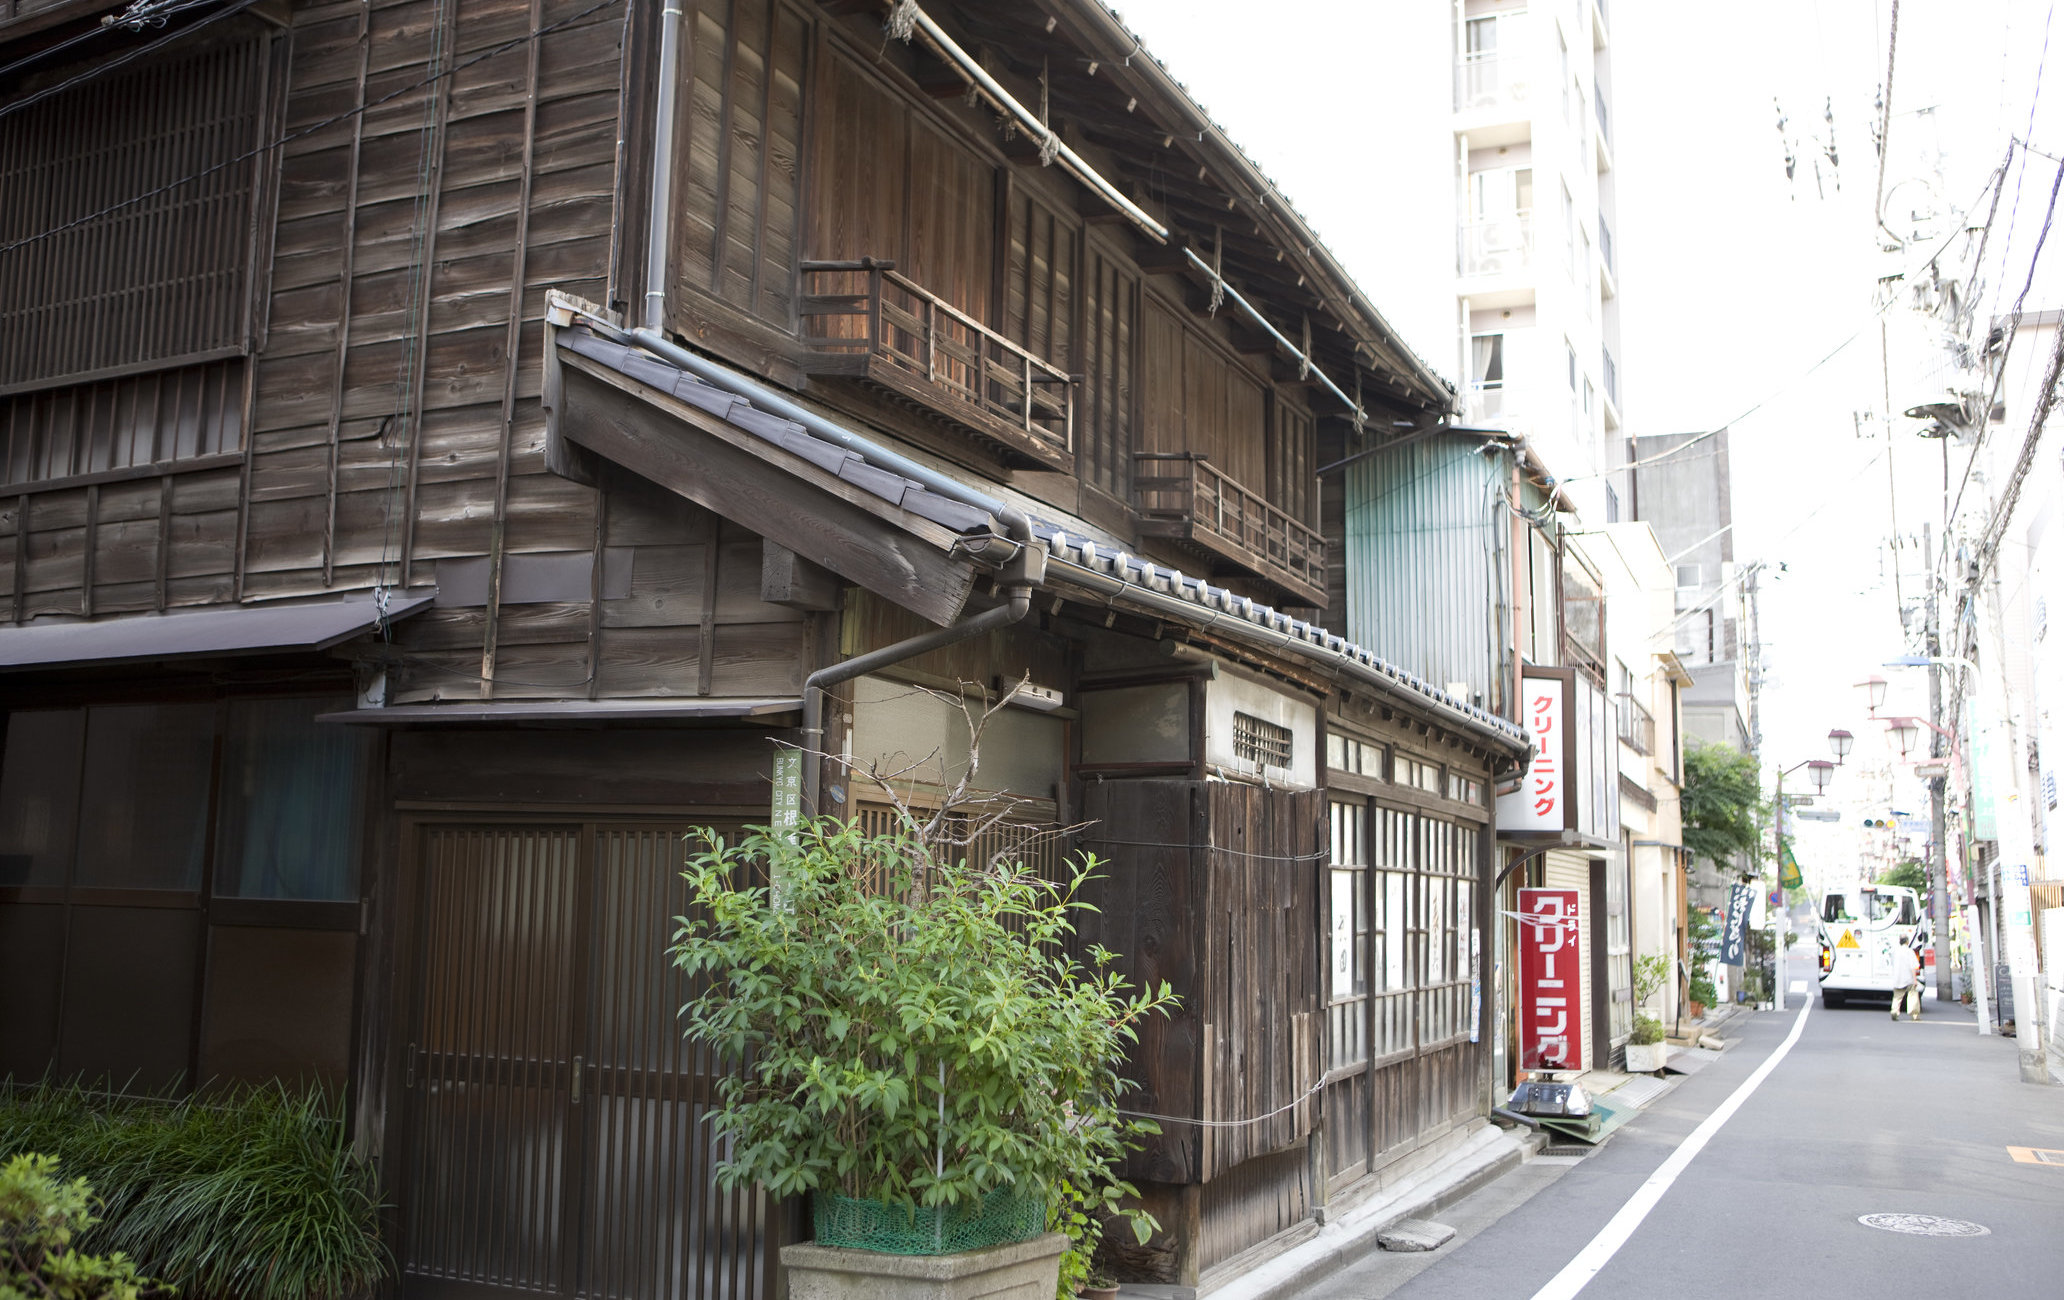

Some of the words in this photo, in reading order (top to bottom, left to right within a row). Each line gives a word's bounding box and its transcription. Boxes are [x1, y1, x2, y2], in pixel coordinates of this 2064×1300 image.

[1533, 696, 1555, 817] クリーニング
[775, 790, 783, 806] CITY
[1567, 904, 1576, 947] ドライ
[1533, 896, 1567, 1066] クリーニング
